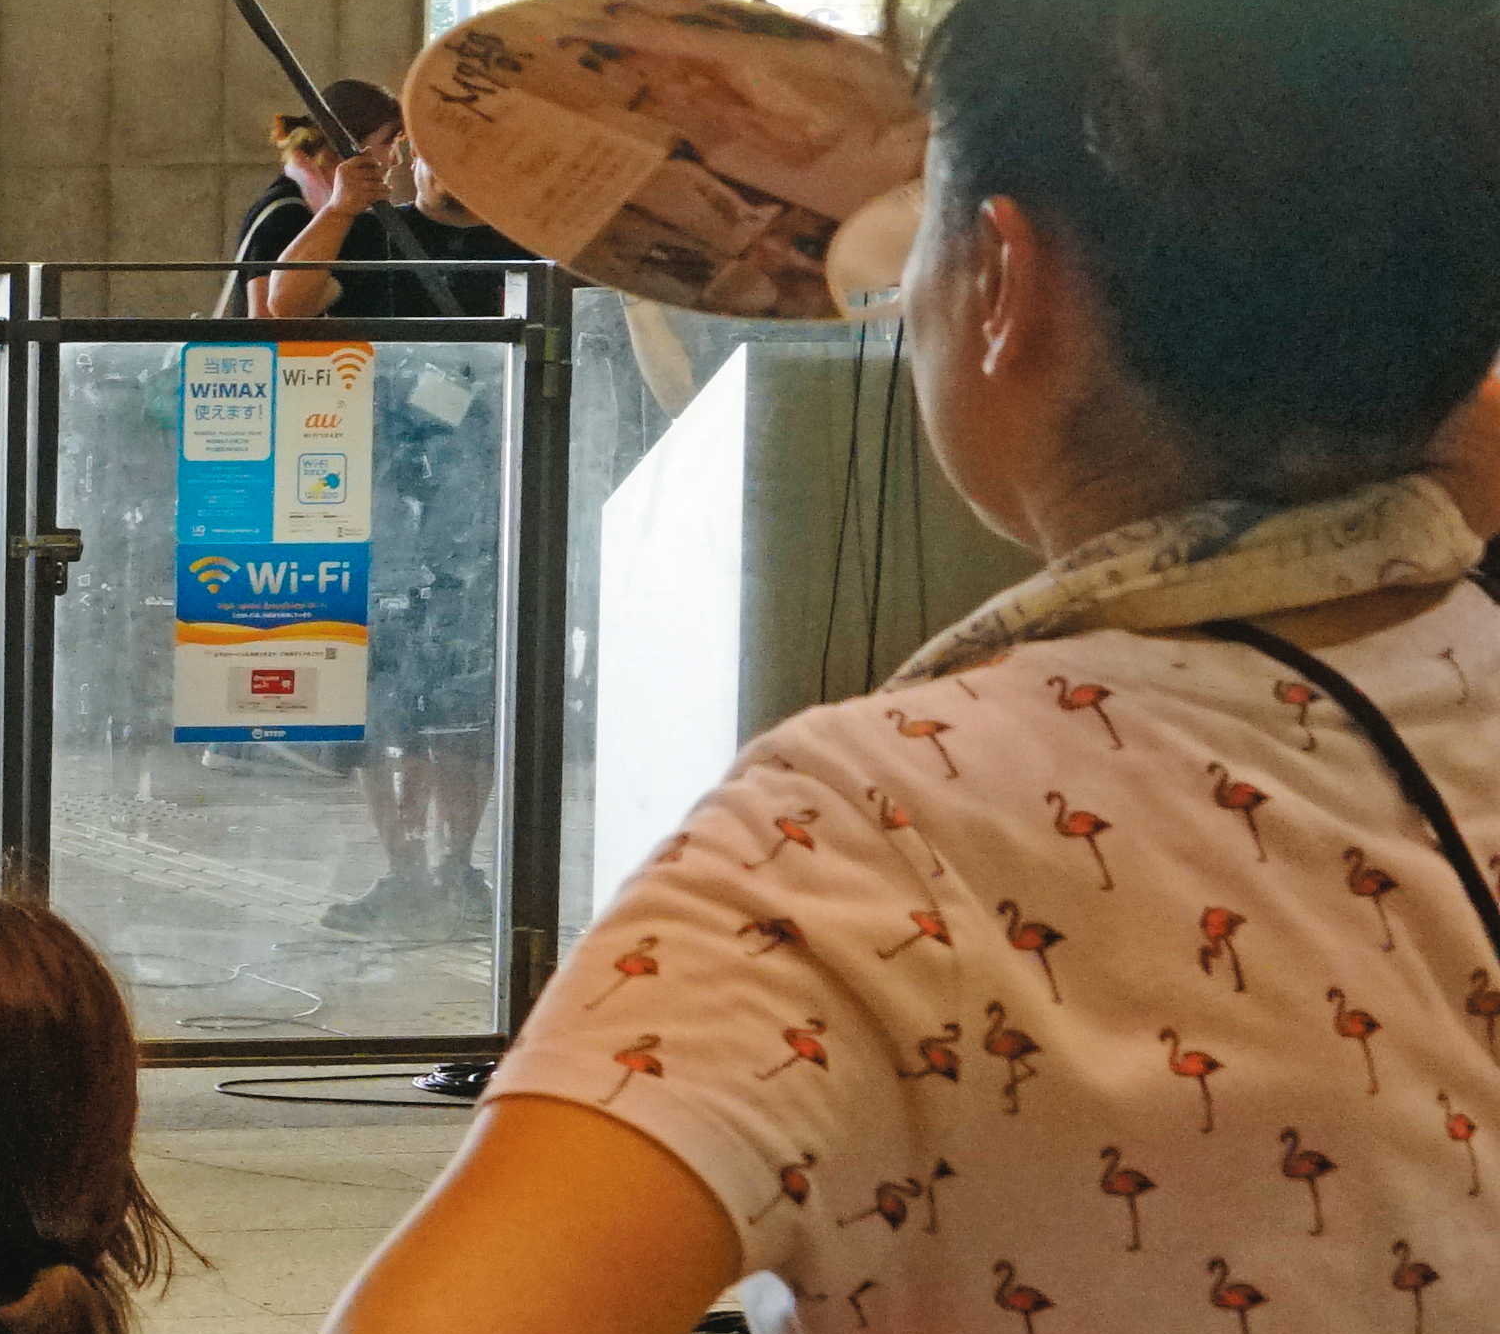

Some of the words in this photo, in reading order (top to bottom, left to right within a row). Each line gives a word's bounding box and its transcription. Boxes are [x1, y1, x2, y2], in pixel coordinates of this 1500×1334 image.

[283, 369, 331, 387] Wi-Fi
[190, 383, 267, 399] WiMAX
[305, 413, 342, 429] au
[246, 561, 350, 595] Wi-Fi
